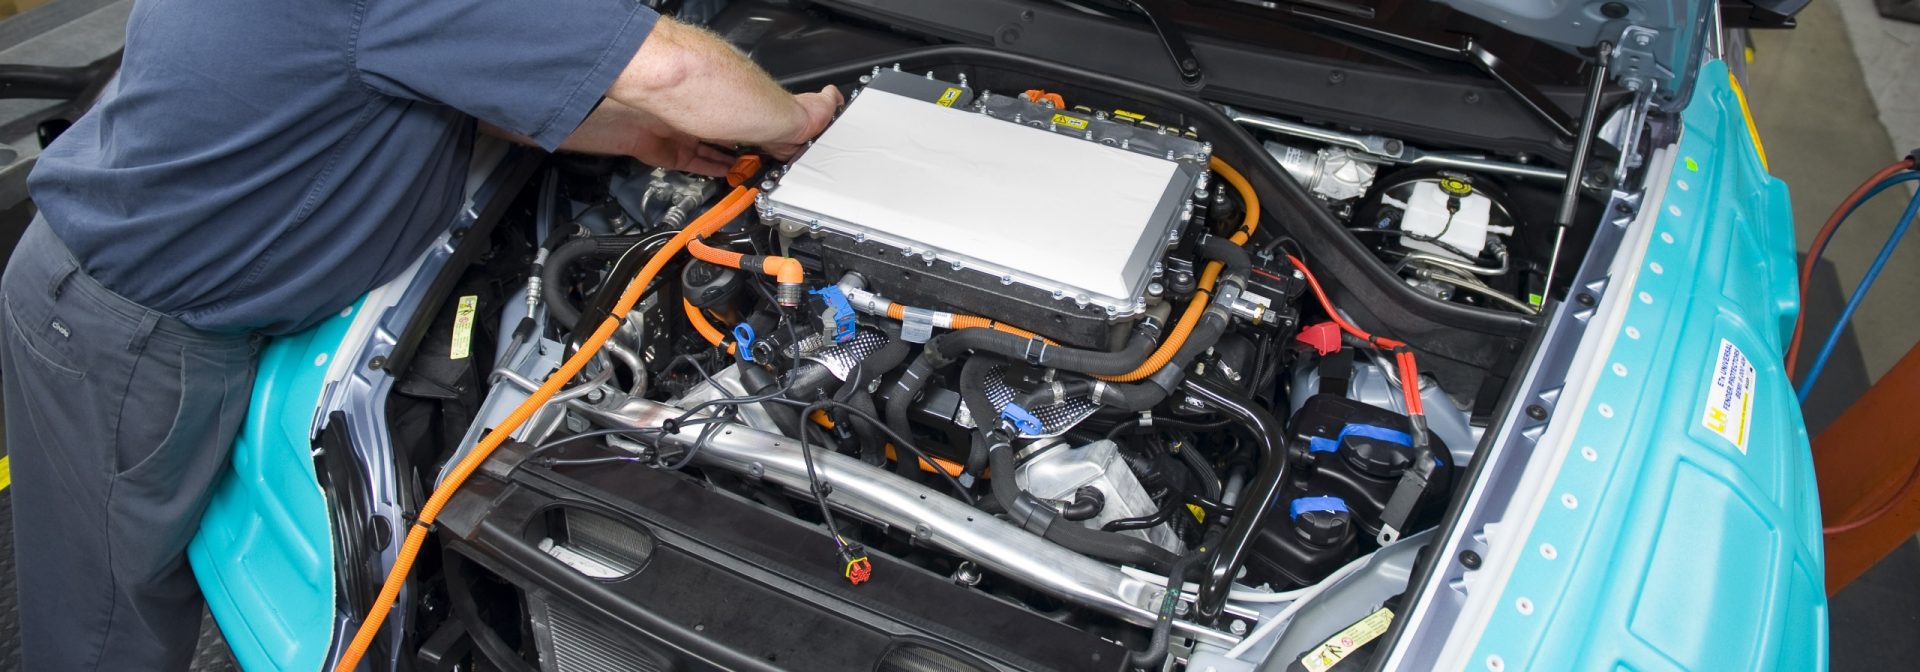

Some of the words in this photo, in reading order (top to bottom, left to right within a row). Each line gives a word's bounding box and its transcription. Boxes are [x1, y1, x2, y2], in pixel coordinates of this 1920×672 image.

[1720, 344, 1732, 375] UNIVERSAL
[1728, 348, 1740, 386] PROTECTORS
[1723, 385, 1734, 411] FENDER
[1707, 407, 1726, 433] LH
